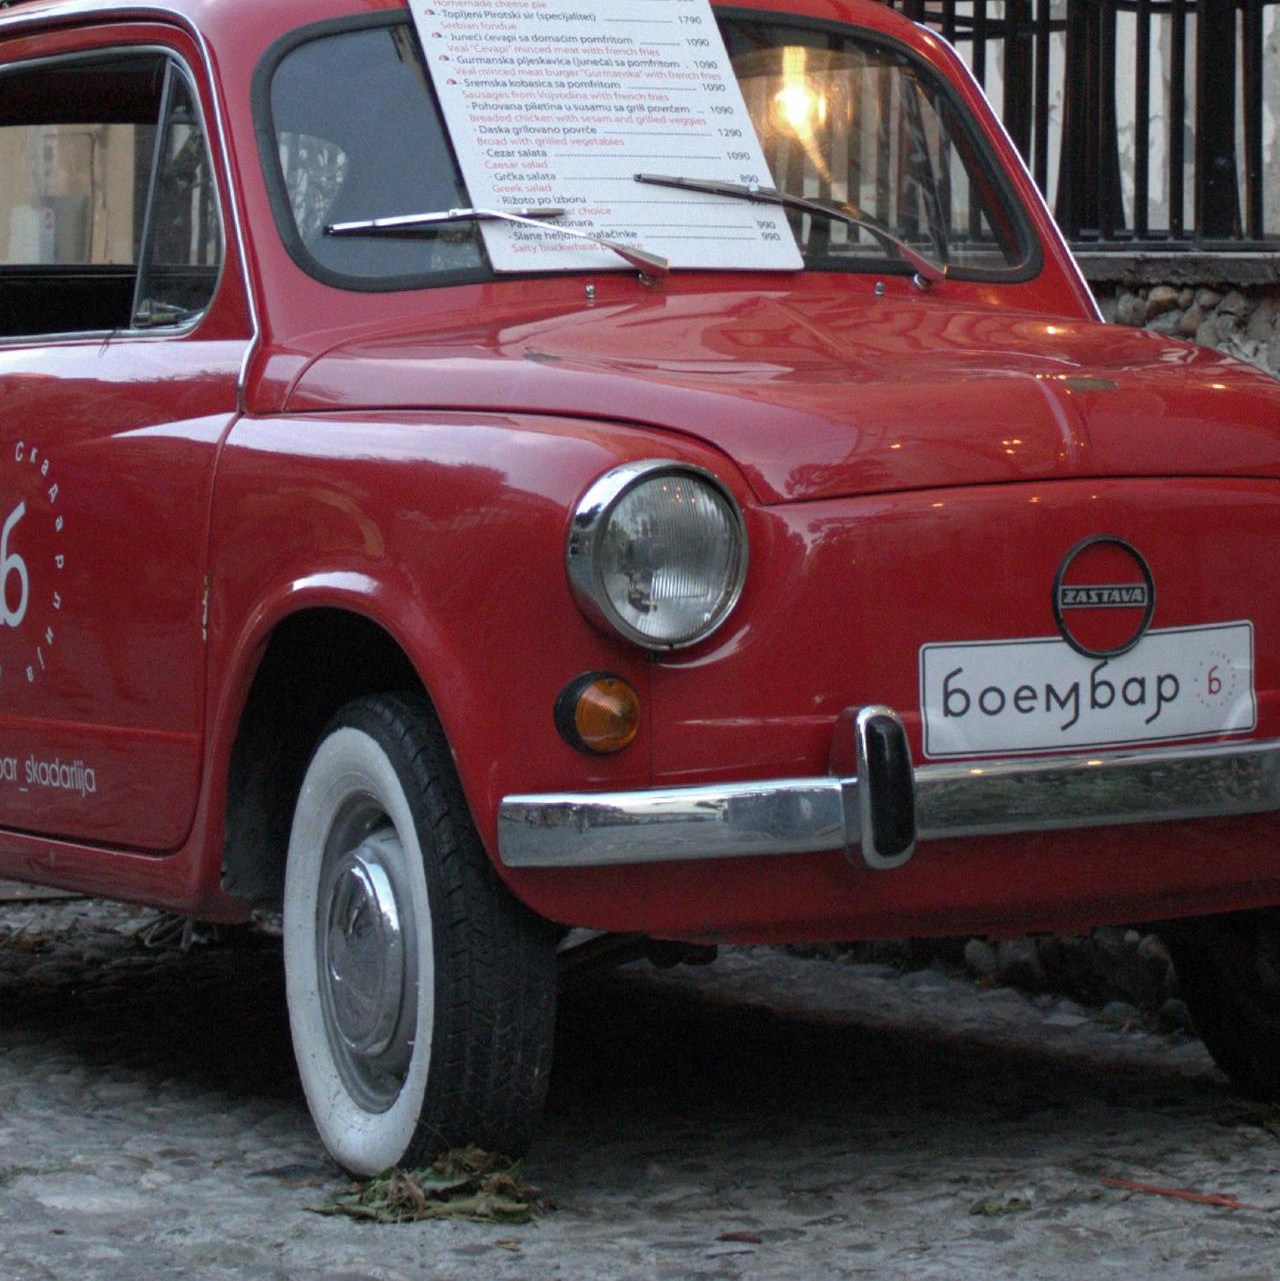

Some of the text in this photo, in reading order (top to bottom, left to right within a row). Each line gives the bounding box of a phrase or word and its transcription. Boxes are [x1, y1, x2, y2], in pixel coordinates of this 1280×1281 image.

[494, 0, 530, 8] cheese
[530, 0, 548, 10] pie
[442, 8, 483, 20] Topljeni
[483, 9, 522, 19] Pirotski
[677, 15, 703, 24] 1790
[439, 20, 518, 30] Serbian fondue
[579, 34, 634, 46] pomfritom
[686, 37, 710, 46] 1090
[447, 43, 469, 52] Veal
[513, 44, 552, 54] minced
[552, 45, 580, 54] meat
[581, 46, 604, 55] with
[604, 46, 638, 55] french
[638, 47, 660, 56] fries
[456, 55, 516, 65] Gurmanska
[626, 58, 681, 70] pomfritom
[694, 60, 719, 69] 1090
[454, 66, 477, 75] Veal
[477, 67, 518, 76] minced
[518, 67, 544, 76] meat
[545, 68, 580, 79] burger
[643, 70, 667, 79] with
[667, 70, 700, 79] french
[699, 71, 722, 80] fries
[463, 78, 507, 87] Sremska
[508, 79, 554, 88] kobasica
[566, 80, 623, 91] pomfritom
[702, 83, 726, 91] 1090
[462, 90, 670, 102] Sausages from Vojvodina with french fries
[471, 101, 524, 111] Pohovana
[710, 105, 735, 114] 1090
[468, 113, 513, 122] Breaded
[513, 114, 554, 123] chicken
[554, 115, 579, 123] with
[614, 116, 635, 124] and
[634, 116, 669, 127] grilled
[668, 116, 708, 127] veggies
[478, 125, 511, 133] Daska
[511, 125, 562, 136] grilovano
[718, 128, 743, 137] 1290
[509, 136, 534, 145] with
[534, 137, 568, 147] grilled
[568, 137, 626, 148] vegetables
[486, 148, 751, 159] Cezar salata 1090
[483, 159, 549, 169] Caesar salad
[526, 172, 557, 181] salata
[739, 174, 760, 182] 890
[491, 183, 553, 193] Greek salad
[538, 198, 553, 207] po
[553, 196, 588, 205] izboru
[576, 206, 613, 215] choice
[546, 219, 595, 229] arbonara
[756, 220, 777, 229] 990
[513, 230, 542, 239] Slane
[761, 232, 781, 241] 990
[511, 243, 538, 255] Salty
[1061, 587, 1146, 604] ZASTAVA
